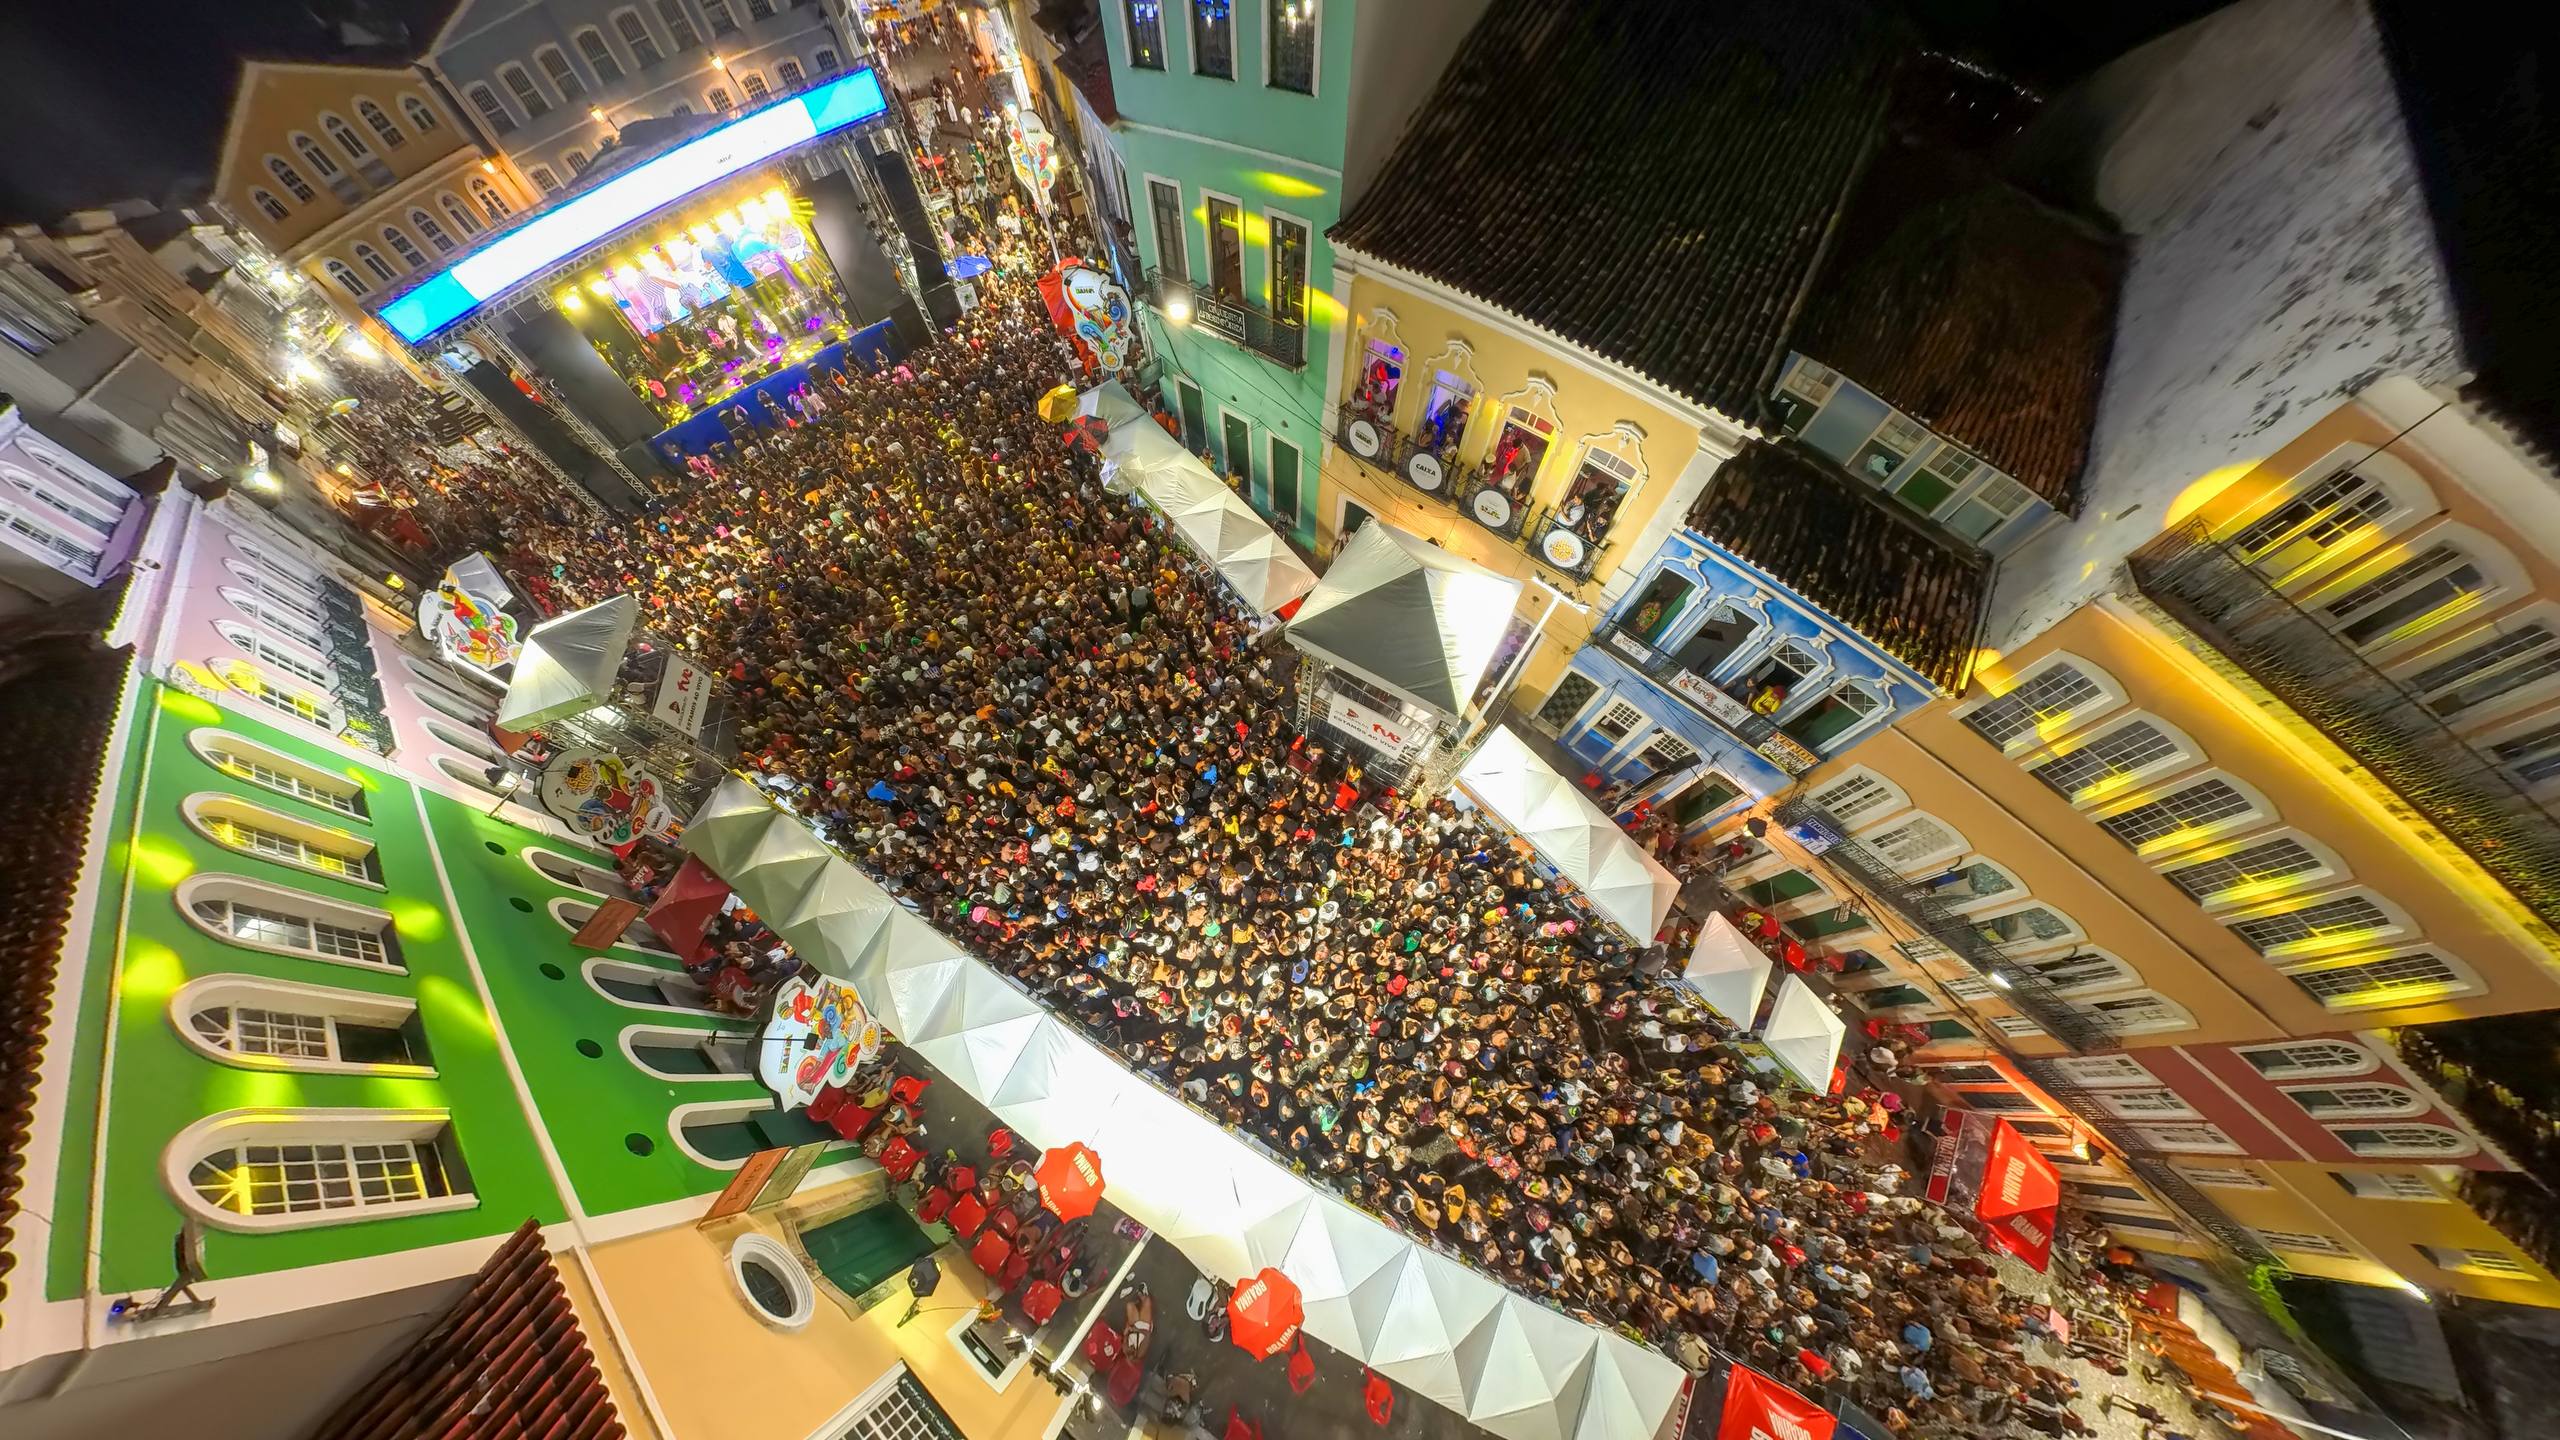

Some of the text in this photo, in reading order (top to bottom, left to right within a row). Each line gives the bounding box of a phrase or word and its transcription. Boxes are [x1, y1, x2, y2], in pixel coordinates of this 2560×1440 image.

[1415, 463, 1436, 477] CAIXA
[685, 702, 697, 731] ESTAMOS
[1333, 715, 1367, 735] ESTAMOS
[1367, 733, 1378, 741] AO
[1380, 740, 1397, 751] VIVO
[1372, 723, 1402, 744] tve
[1775, 732, 1818, 765] VENDO
[1073, 1150, 1098, 1187] BRAHMA
[1934, 1135, 1957, 1177] BRAHMA
[2001, 1155, 2027, 1207] BRAHMA
[1040, 1184, 1062, 1217] BRAHMA
[2009, 1214, 2048, 1249] BRAHMA
[1235, 1279, 1268, 1313] BRAHMA
[1265, 1324, 1299, 1355] BRAHMA
